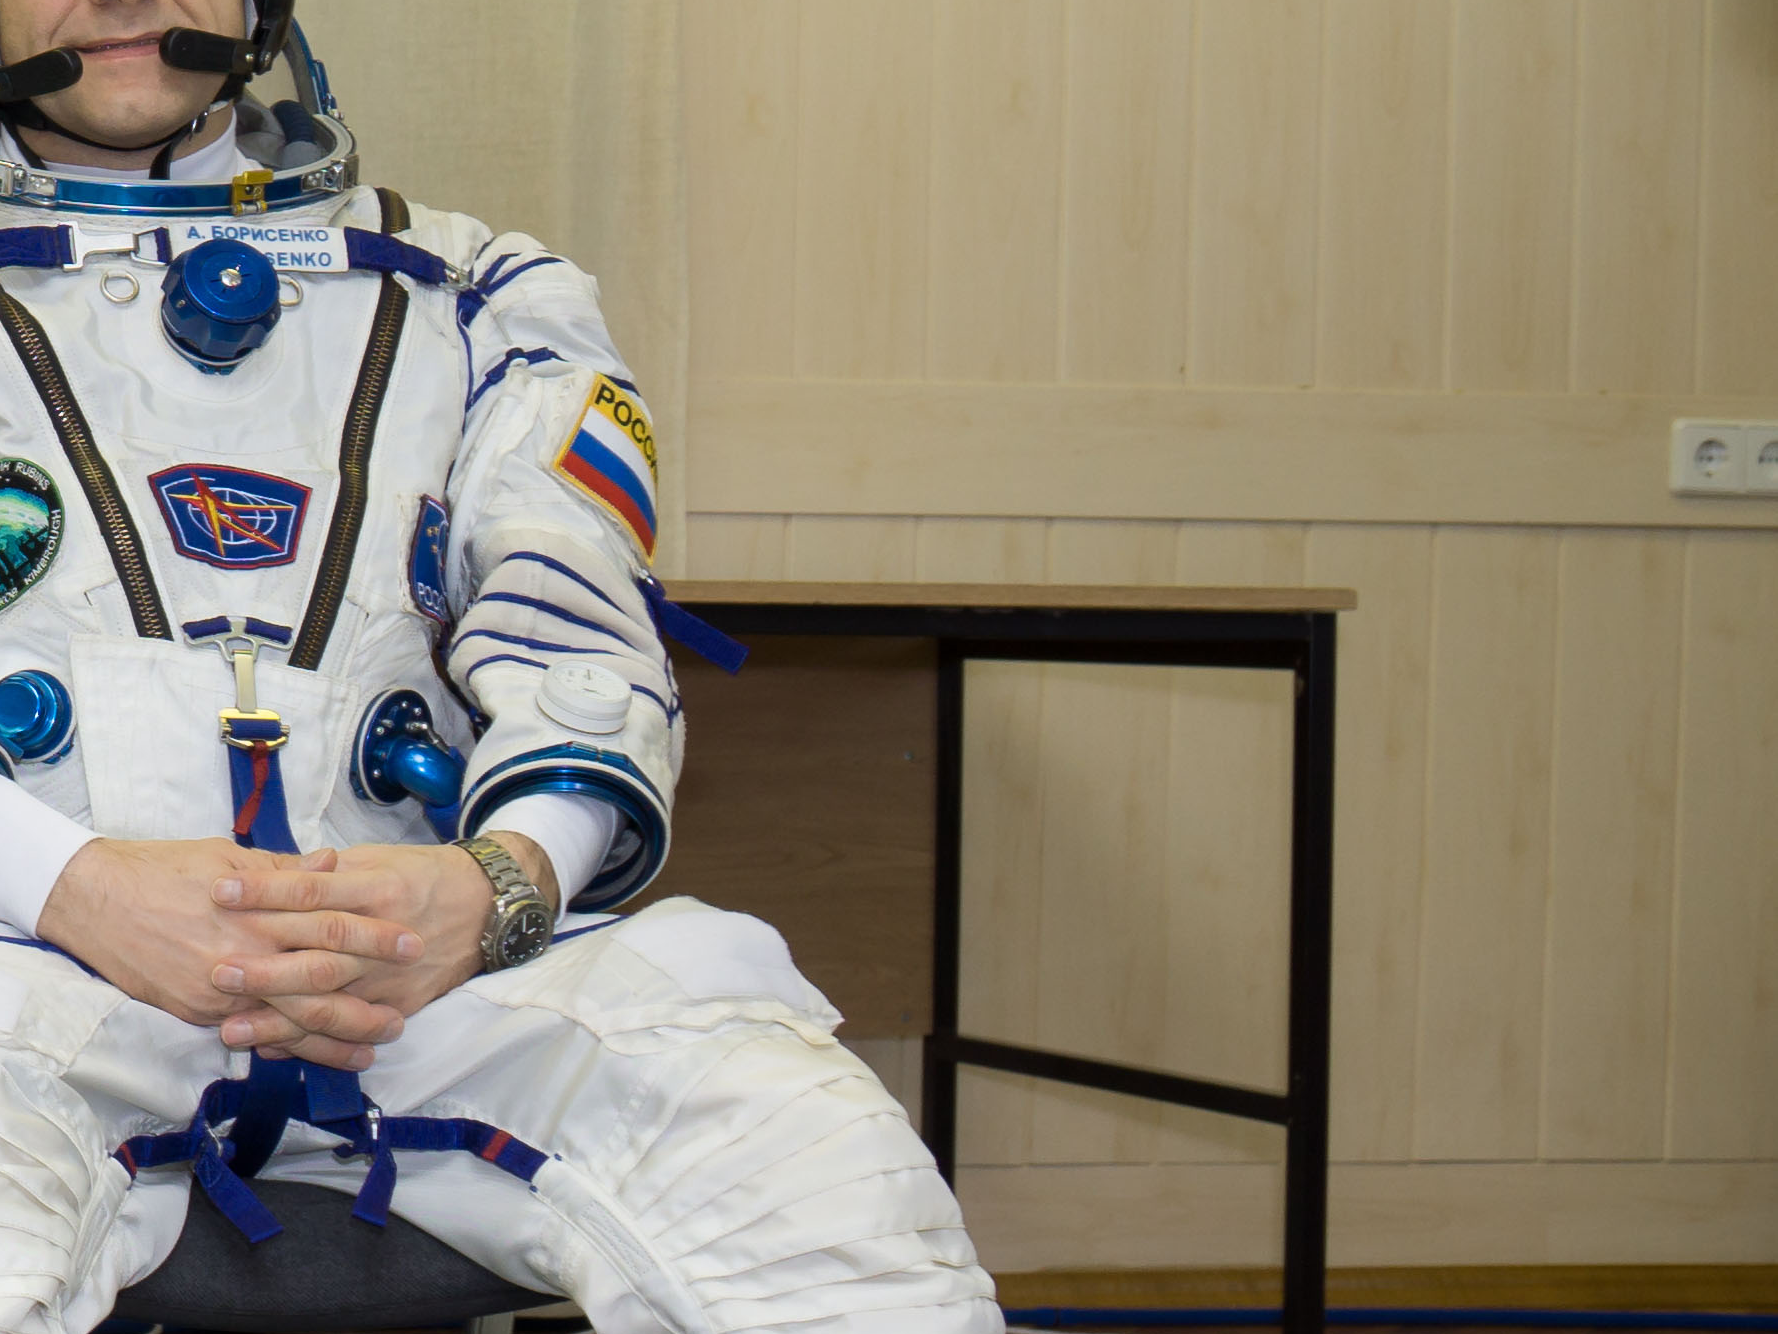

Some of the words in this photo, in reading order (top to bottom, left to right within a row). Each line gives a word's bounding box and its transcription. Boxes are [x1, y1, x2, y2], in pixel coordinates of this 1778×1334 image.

[187, 226, 206, 240] А.
[211, 225, 329, 242] БОРИСЕНКО
[267, 252, 332, 267] SENKO
